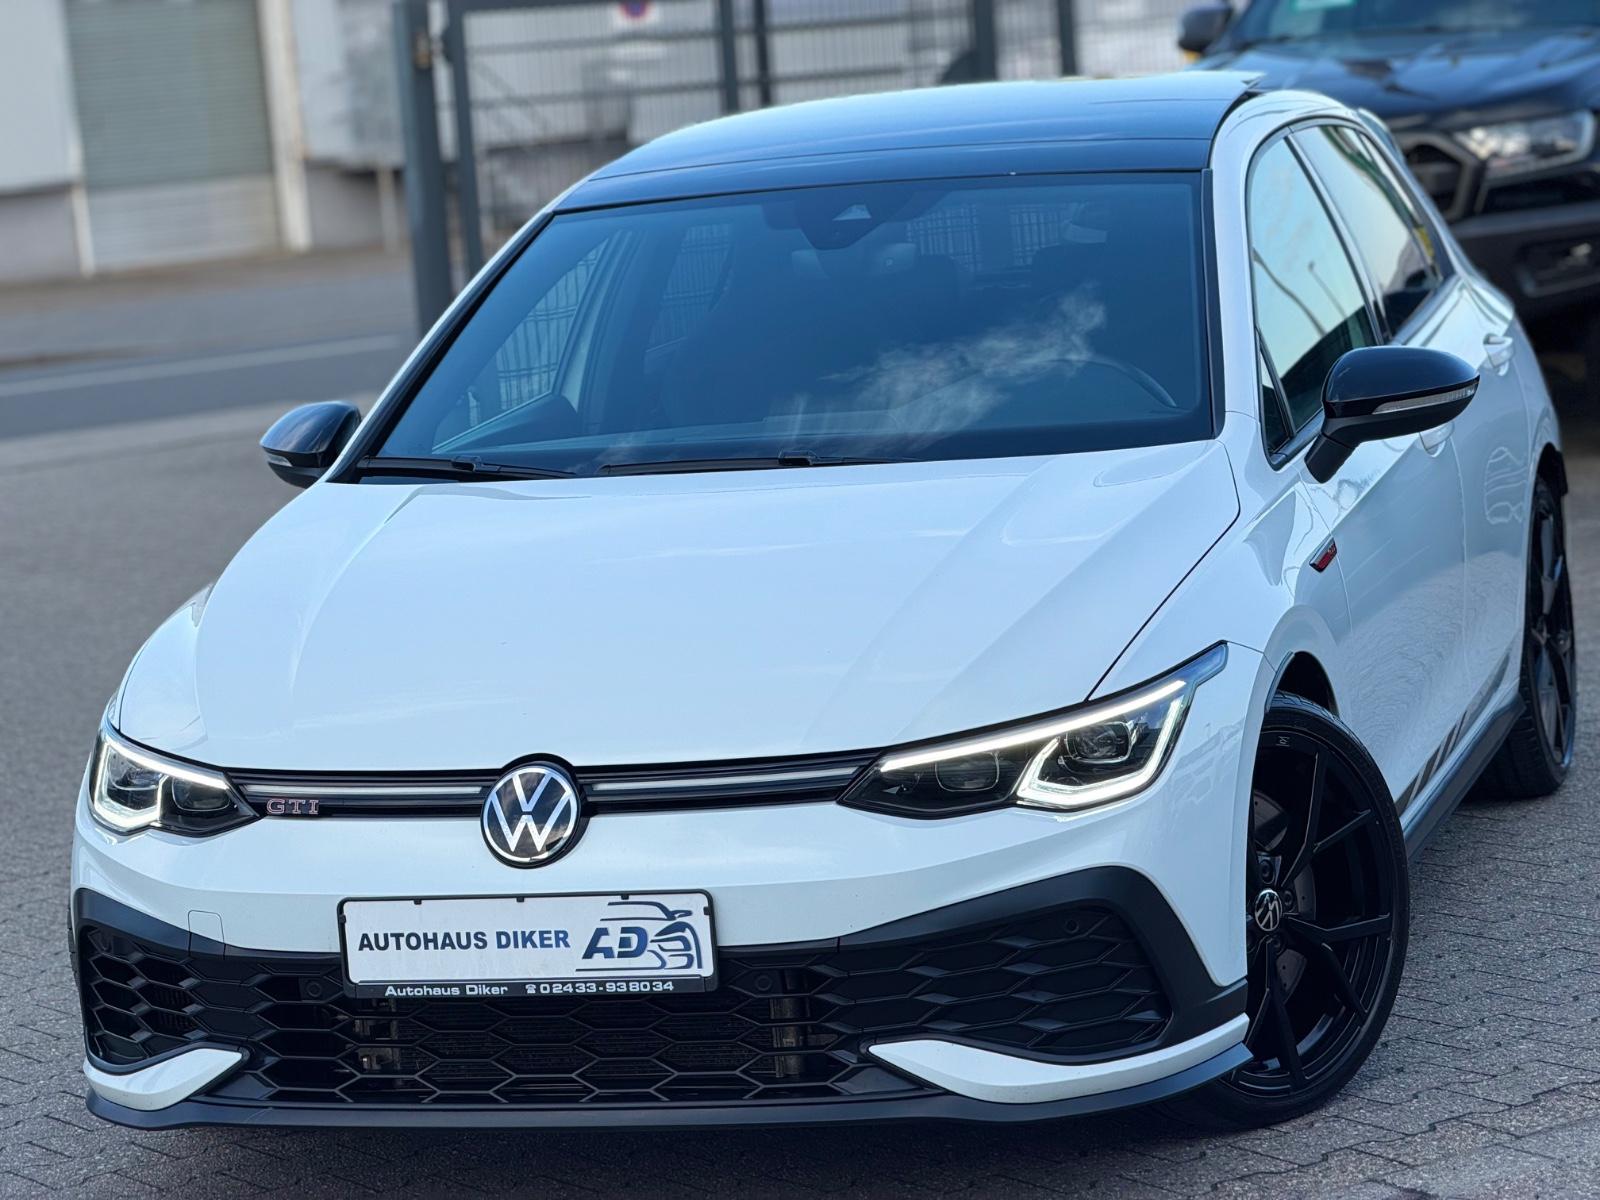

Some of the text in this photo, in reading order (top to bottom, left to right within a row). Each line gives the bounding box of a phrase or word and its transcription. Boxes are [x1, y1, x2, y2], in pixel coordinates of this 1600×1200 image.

[266, 798, 320, 815] GTI
[358, 930, 571, 951] AUTOHAUS DIKER
[582, 926, 648, 960] AD
[385, 985, 460, 997] Autohaus
[466, 984, 508, 996] Diker
